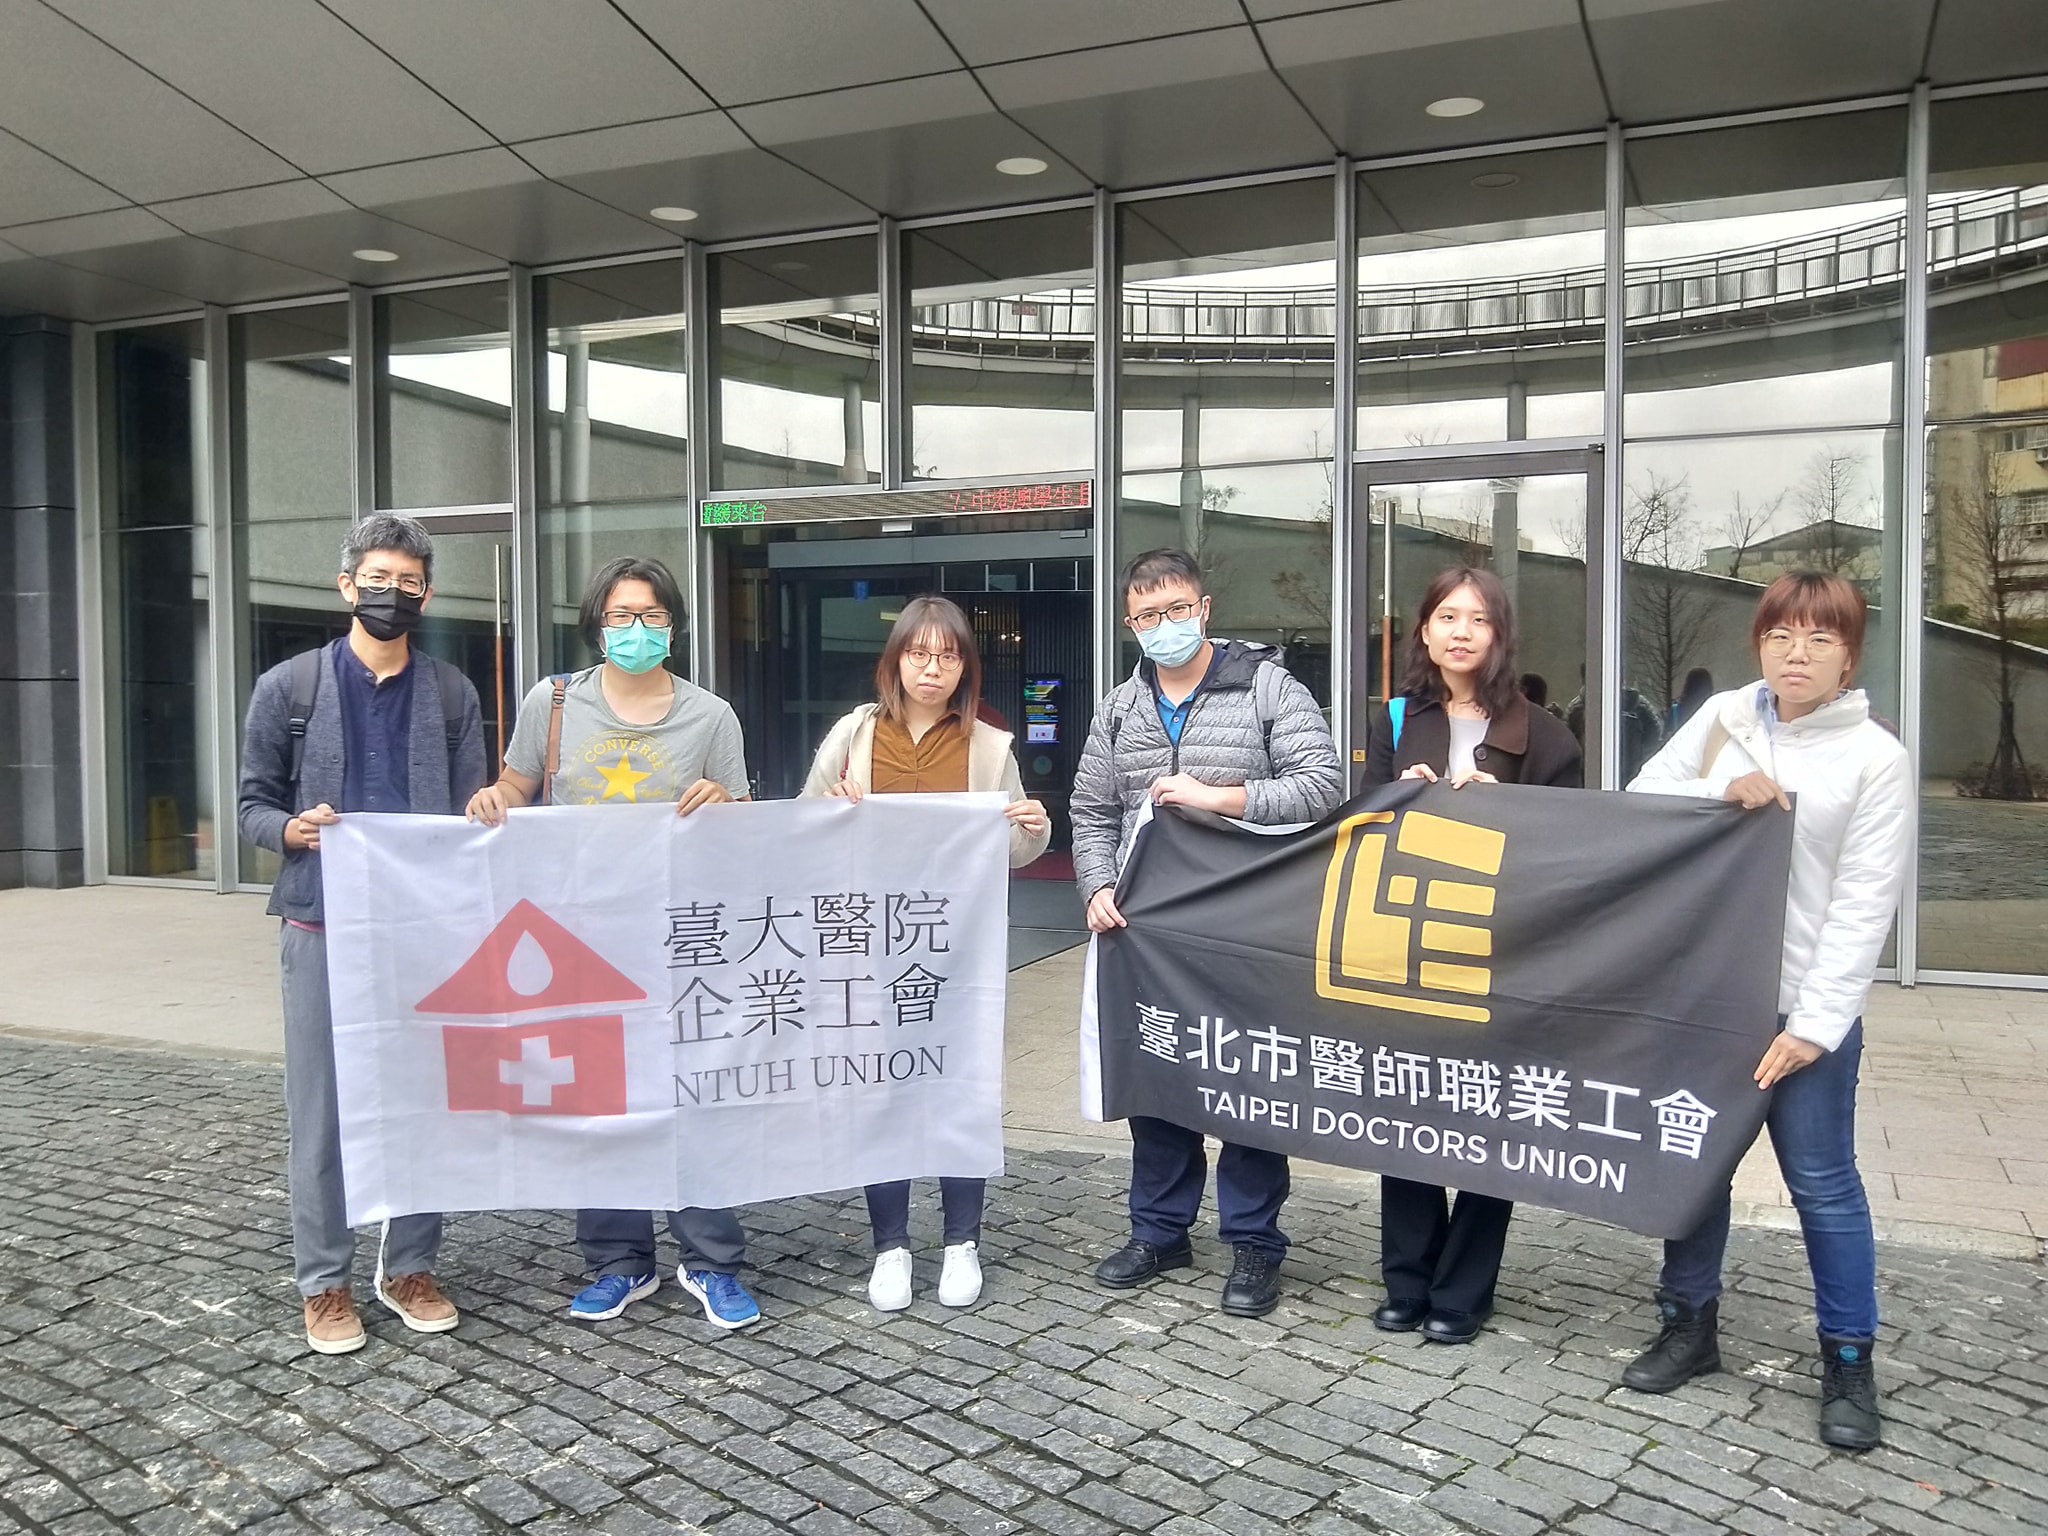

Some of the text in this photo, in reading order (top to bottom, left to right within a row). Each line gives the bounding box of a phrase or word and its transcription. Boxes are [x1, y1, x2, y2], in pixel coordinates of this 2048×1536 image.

[584, 738, 665, 771] CONVERSE
[663, 890, 951, 969] 臺大醫院
[666, 962, 949, 1044] 企業工會
[672, 1045, 948, 1108] NTUH UNION
[1135, 1001, 1718, 1160] 臺北市醫師職業工會
[1197, 1086, 1627, 1193] TAIPEI DOCTORS UNION
